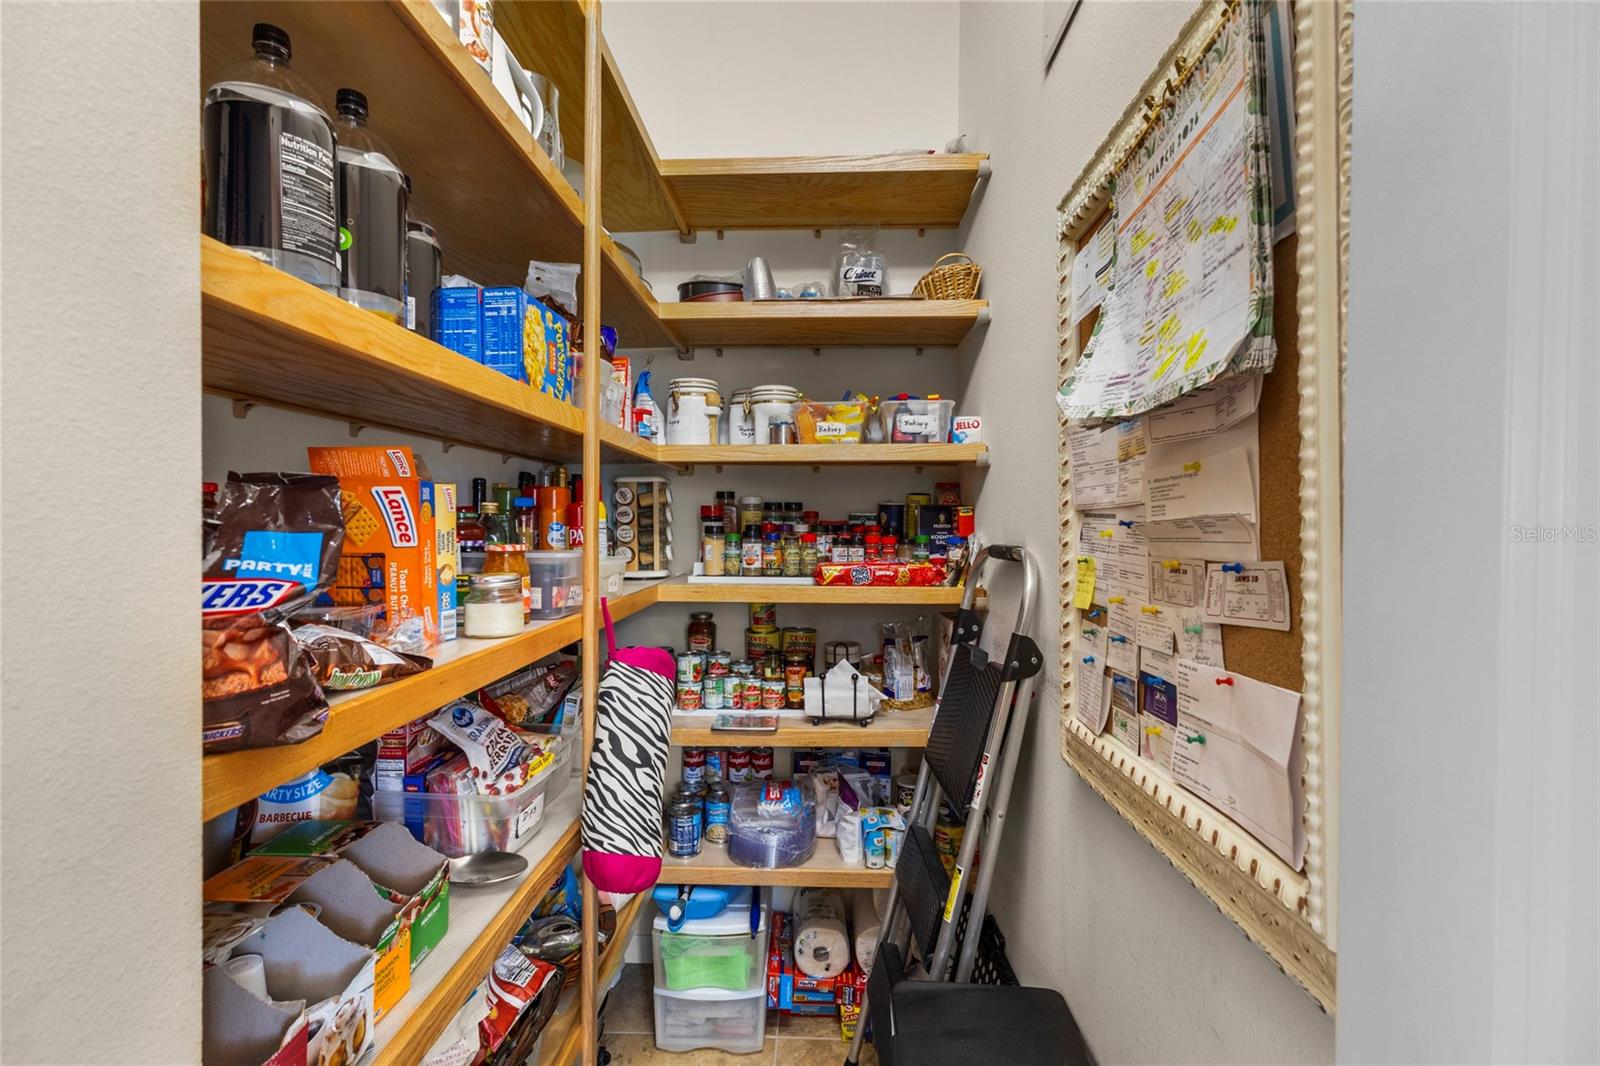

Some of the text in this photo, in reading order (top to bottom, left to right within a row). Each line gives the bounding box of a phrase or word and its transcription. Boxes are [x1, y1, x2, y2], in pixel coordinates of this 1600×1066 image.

[281, 138, 318, 158] Nutrition
[1148, 142, 1175, 184] MARCH
[954, 419, 981, 431] JELL-O
[392, 451, 408, 475] Lance
[383, 489, 412, 543] Lance
[223, 559, 303, 576] PARTY
[389, 562, 398, 593] PEANUT
[400, 568, 408, 592] Toast
[203, 583, 285, 609] ERS
[294, 778, 324, 798] SIZE
[259, 811, 313, 823] BARBECUE
